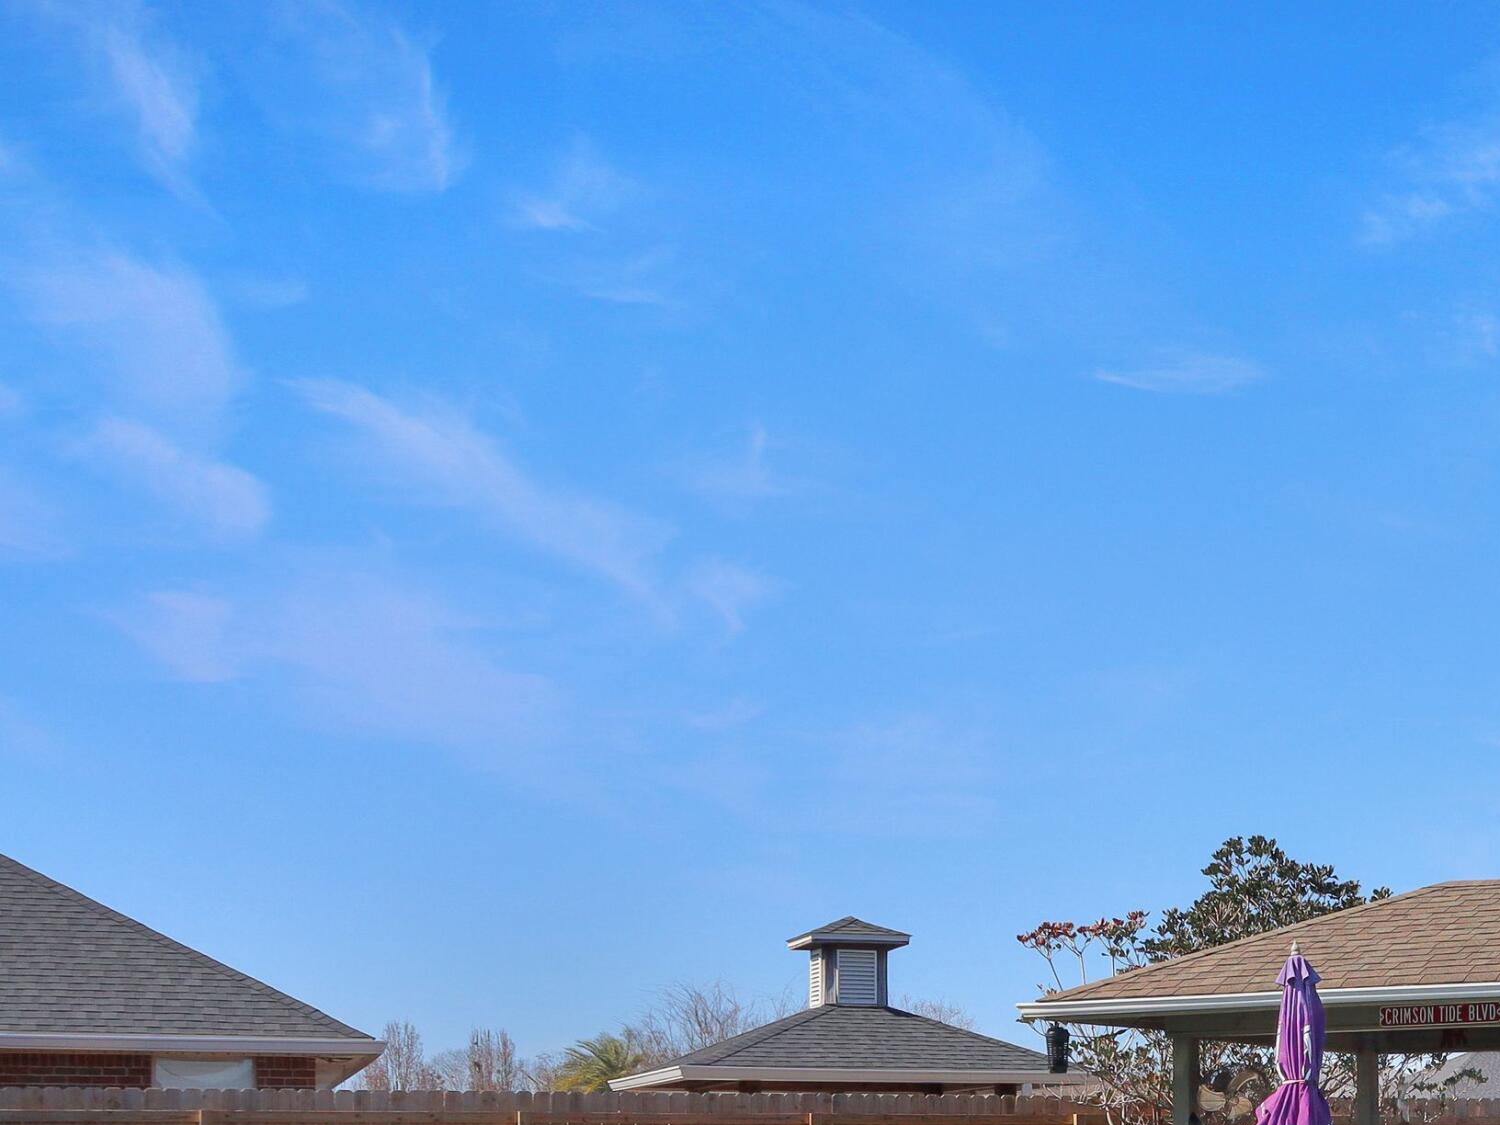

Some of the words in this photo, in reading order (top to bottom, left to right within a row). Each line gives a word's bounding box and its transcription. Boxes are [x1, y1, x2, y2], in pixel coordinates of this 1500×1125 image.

[1385, 1007, 1434, 1025] CRIMSON
[1439, 1005, 1463, 1022] TIDE
[1468, 1004, 1496, 1021] BLVD
